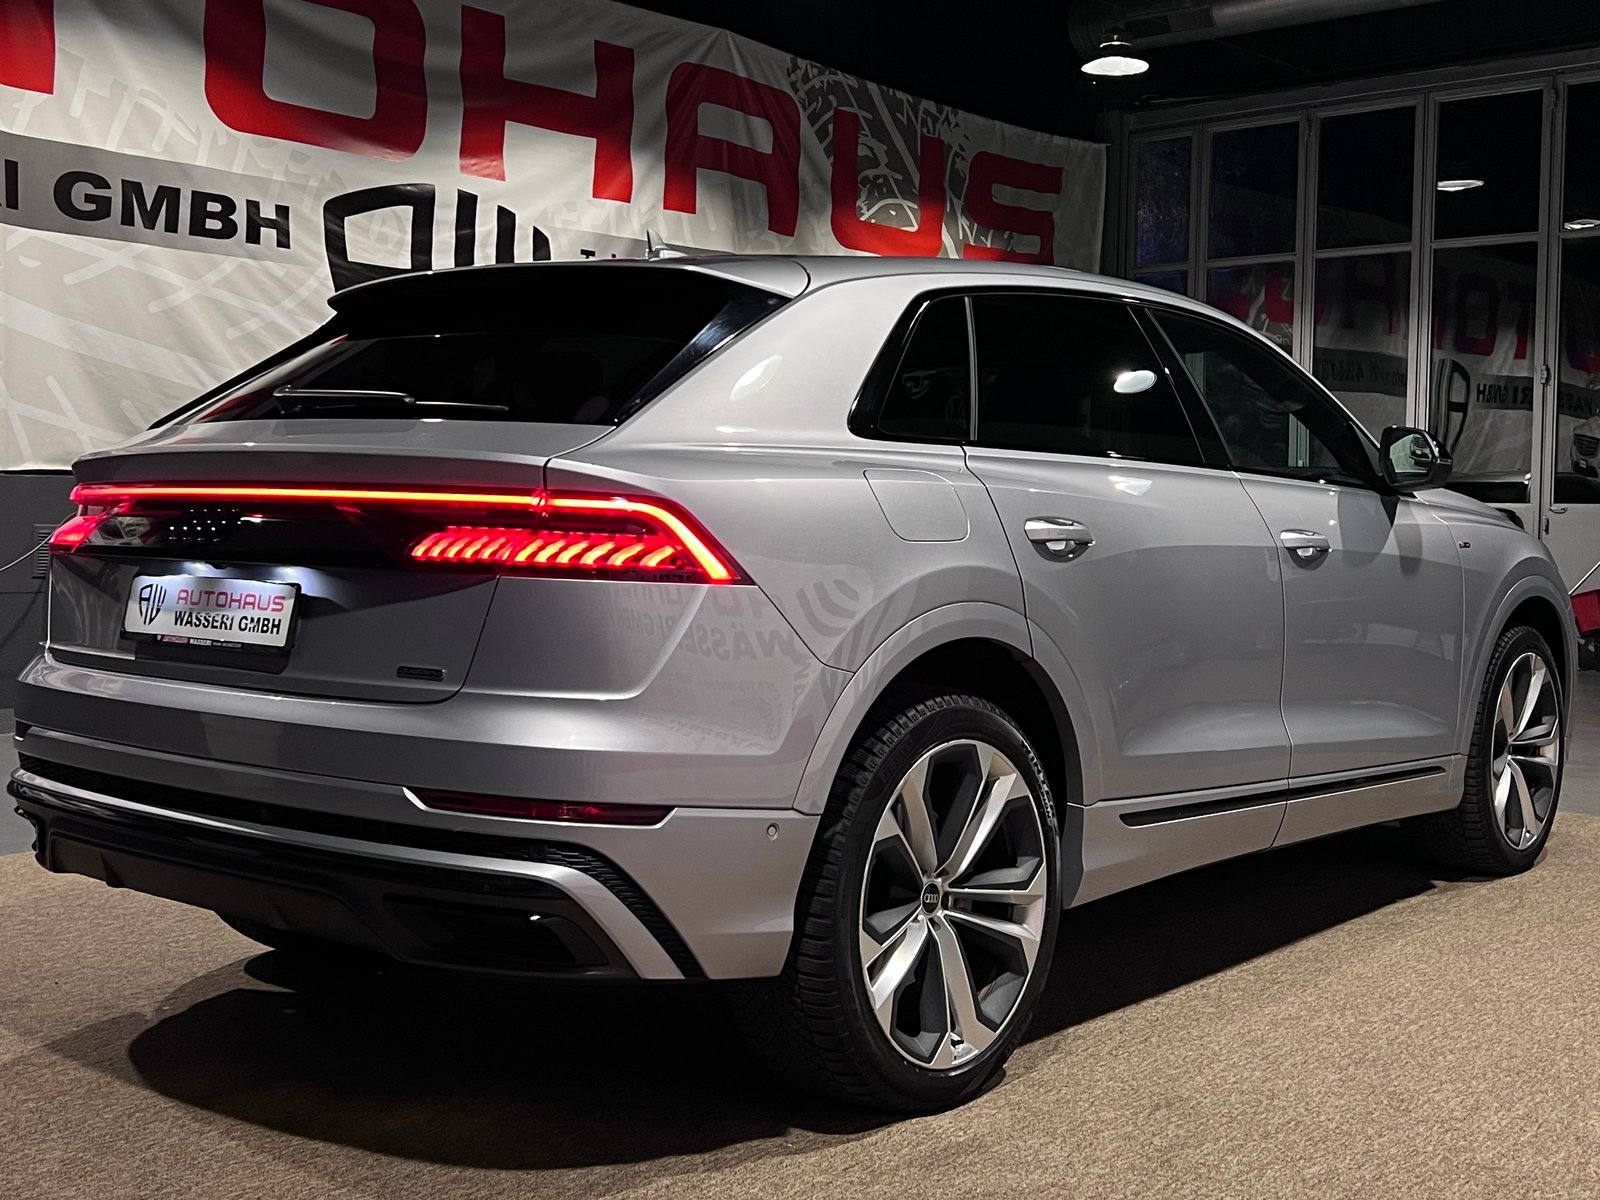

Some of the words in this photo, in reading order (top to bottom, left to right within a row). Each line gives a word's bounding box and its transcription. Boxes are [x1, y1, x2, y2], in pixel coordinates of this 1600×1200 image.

[0, 0, 1063, 265] OHAUS
[52, 170, 292, 249] GMBH
[176, 588, 286, 612] AUTOHAUS
[238, 615, 282, 635] GMBH
